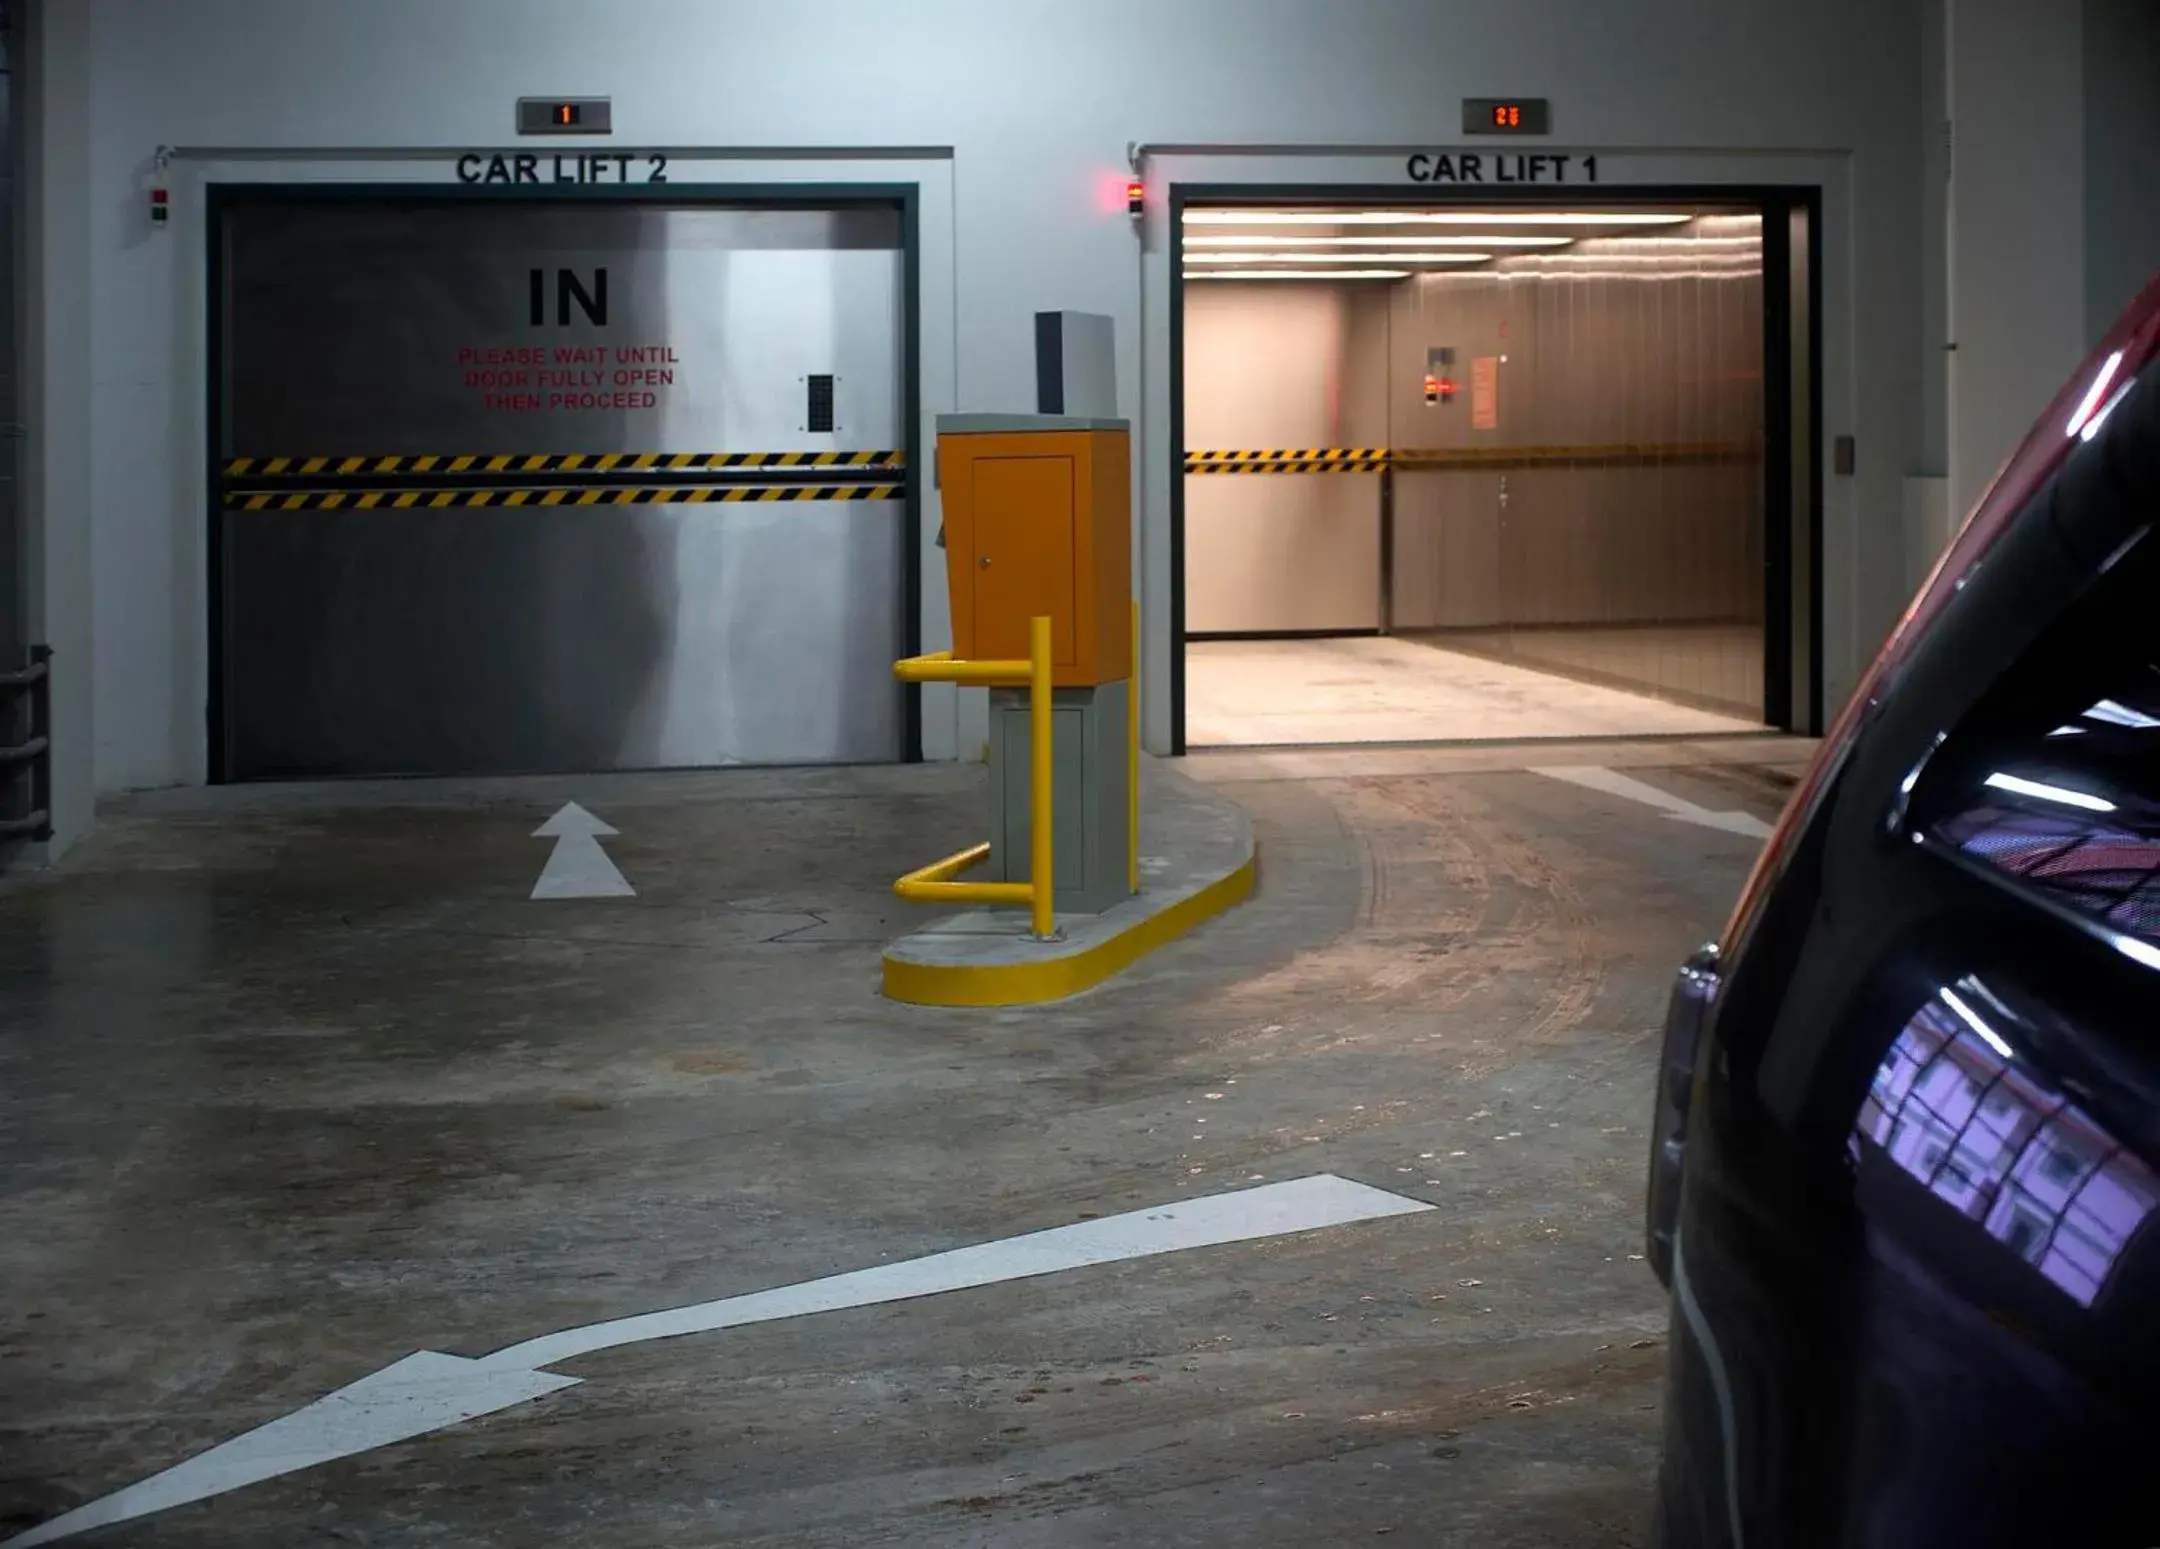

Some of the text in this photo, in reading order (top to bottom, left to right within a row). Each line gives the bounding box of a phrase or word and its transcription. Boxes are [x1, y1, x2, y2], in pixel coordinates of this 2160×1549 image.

[560, 104, 570, 125] 1
[457, 153, 667, 183] CAR LIFT 2
[1407, 154, 1597, 183] CAR LIFT 1
[530, 268, 607, 326] IN
[457, 347, 679, 365] PLEASE WAIT UNTIL
[466, 369, 673, 387] DOOR FULLY OPEN
[485, 392, 656, 409] THEN PROCEED
